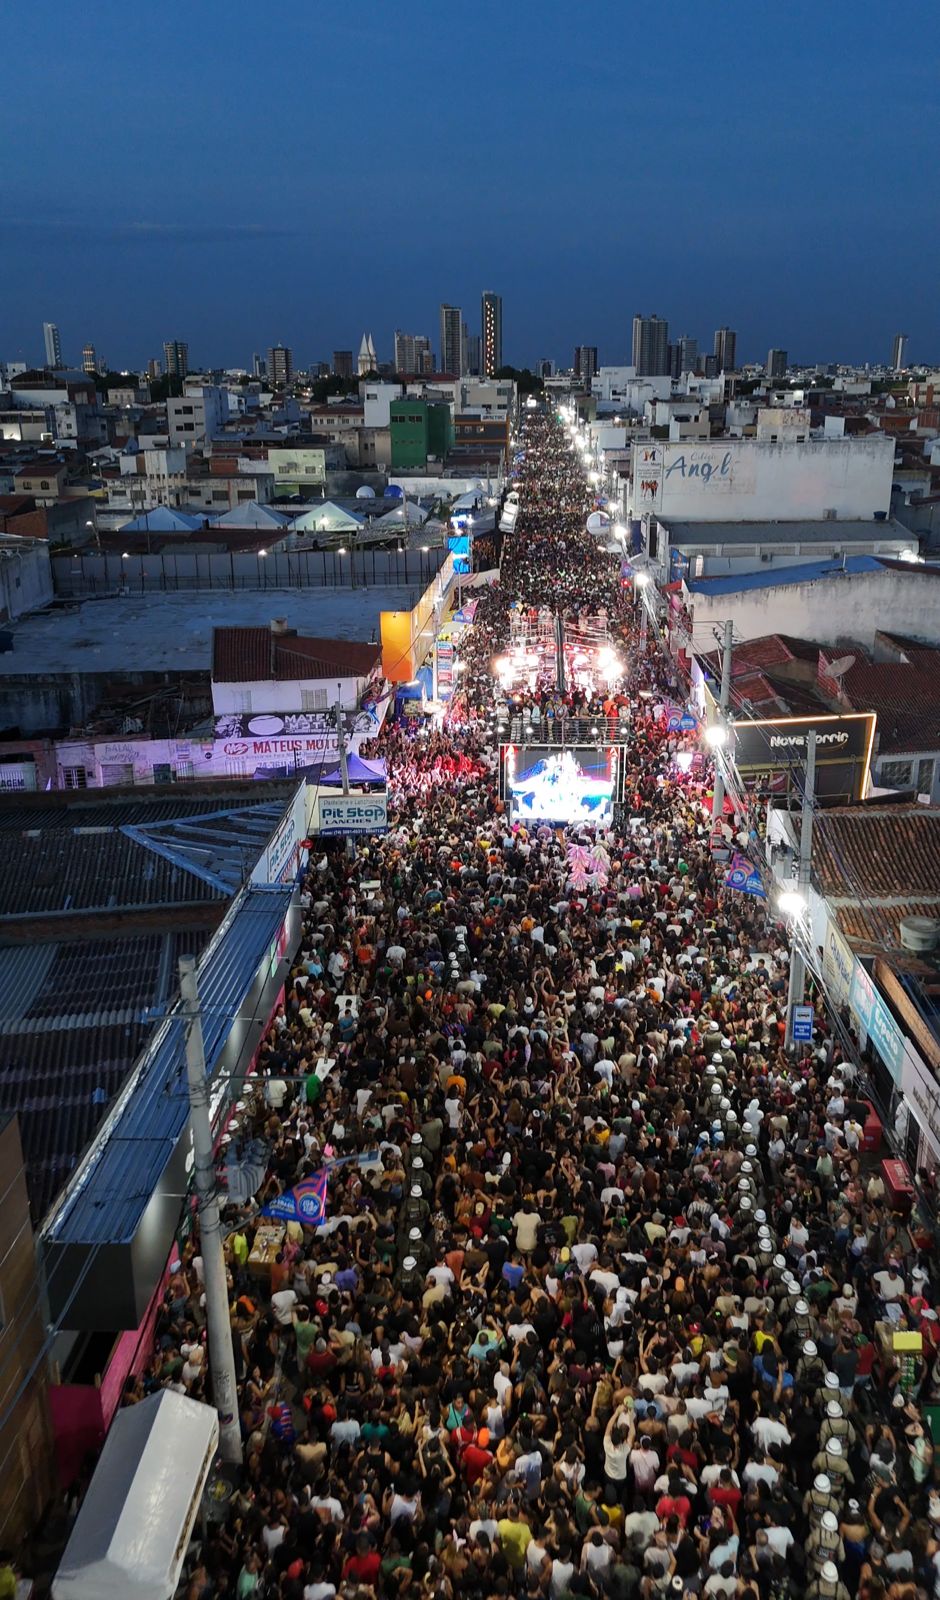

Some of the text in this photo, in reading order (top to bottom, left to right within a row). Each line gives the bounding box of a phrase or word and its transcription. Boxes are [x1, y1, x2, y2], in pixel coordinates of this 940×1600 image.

[253, 739, 303, 754] MATEUS
[770, 731, 849, 747] Nova orrir
[322, 807, 385, 820] Pit Stop
